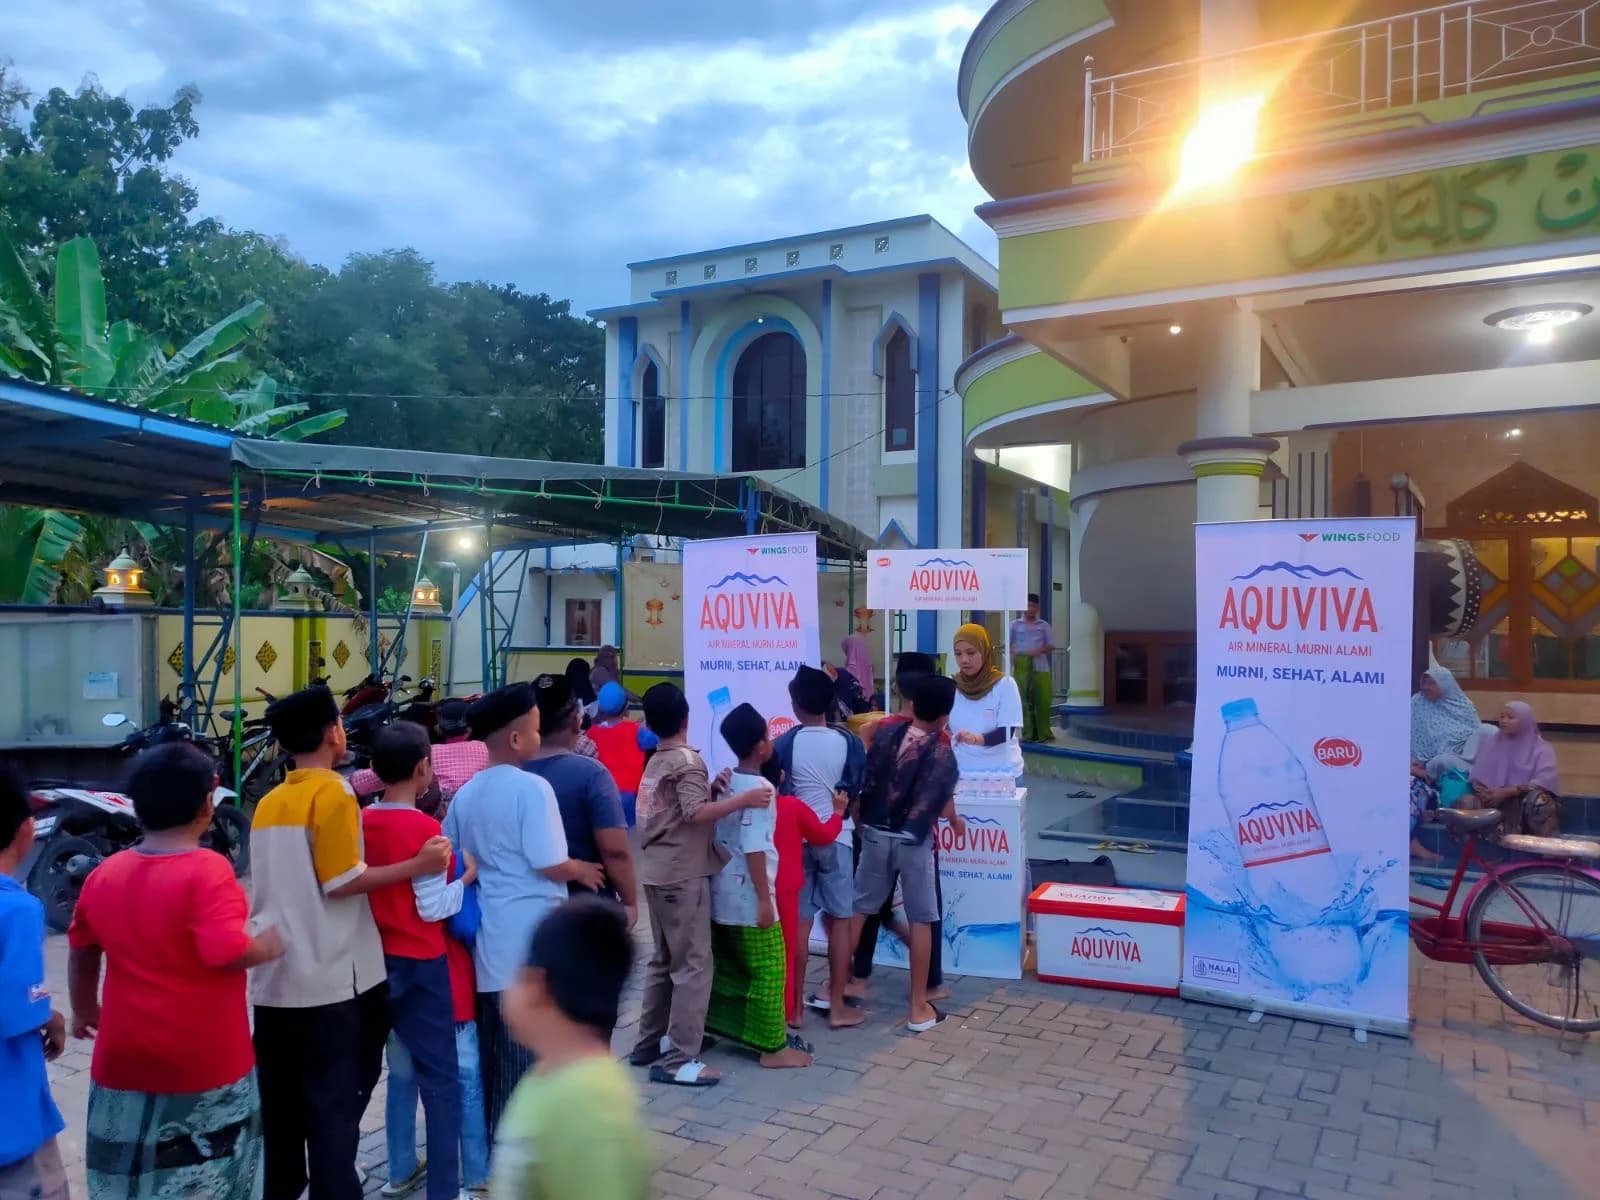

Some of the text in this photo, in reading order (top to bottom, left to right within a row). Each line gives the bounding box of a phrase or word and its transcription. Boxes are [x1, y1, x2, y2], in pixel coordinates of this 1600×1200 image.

[1322, 533, 1400, 542] WINGSFOOD
[761, 545, 808, 554] WINGSFOOD
[910, 569, 979, 592] AQUVIVA
[700, 591, 799, 632] AQUVIVA
[1219, 586, 1379, 634] AQUVIVA
[722, 640, 750, 648] MINERAL
[753, 640, 774, 648] MURNI
[776, 640, 798, 648] ALAMI
[1228, 641, 1372, 657] AIR MINERAL MURNI ALAMI
[700, 661, 735, 672] MURNI,
[737, 661, 771, 672] SEHAT,
[1216, 665, 1385, 685] MURNI, SEHAT, ALAMI
[1317, 746, 1356, 760] BARU
[1238, 807, 1320, 845] AQUVIVA
[957, 871, 984, 880] SEHAT,
[987, 872, 1012, 880] ALAMI
[1071, 936, 1141, 963] AQUVIVA
[1208, 963, 1237, 974] HALAL
